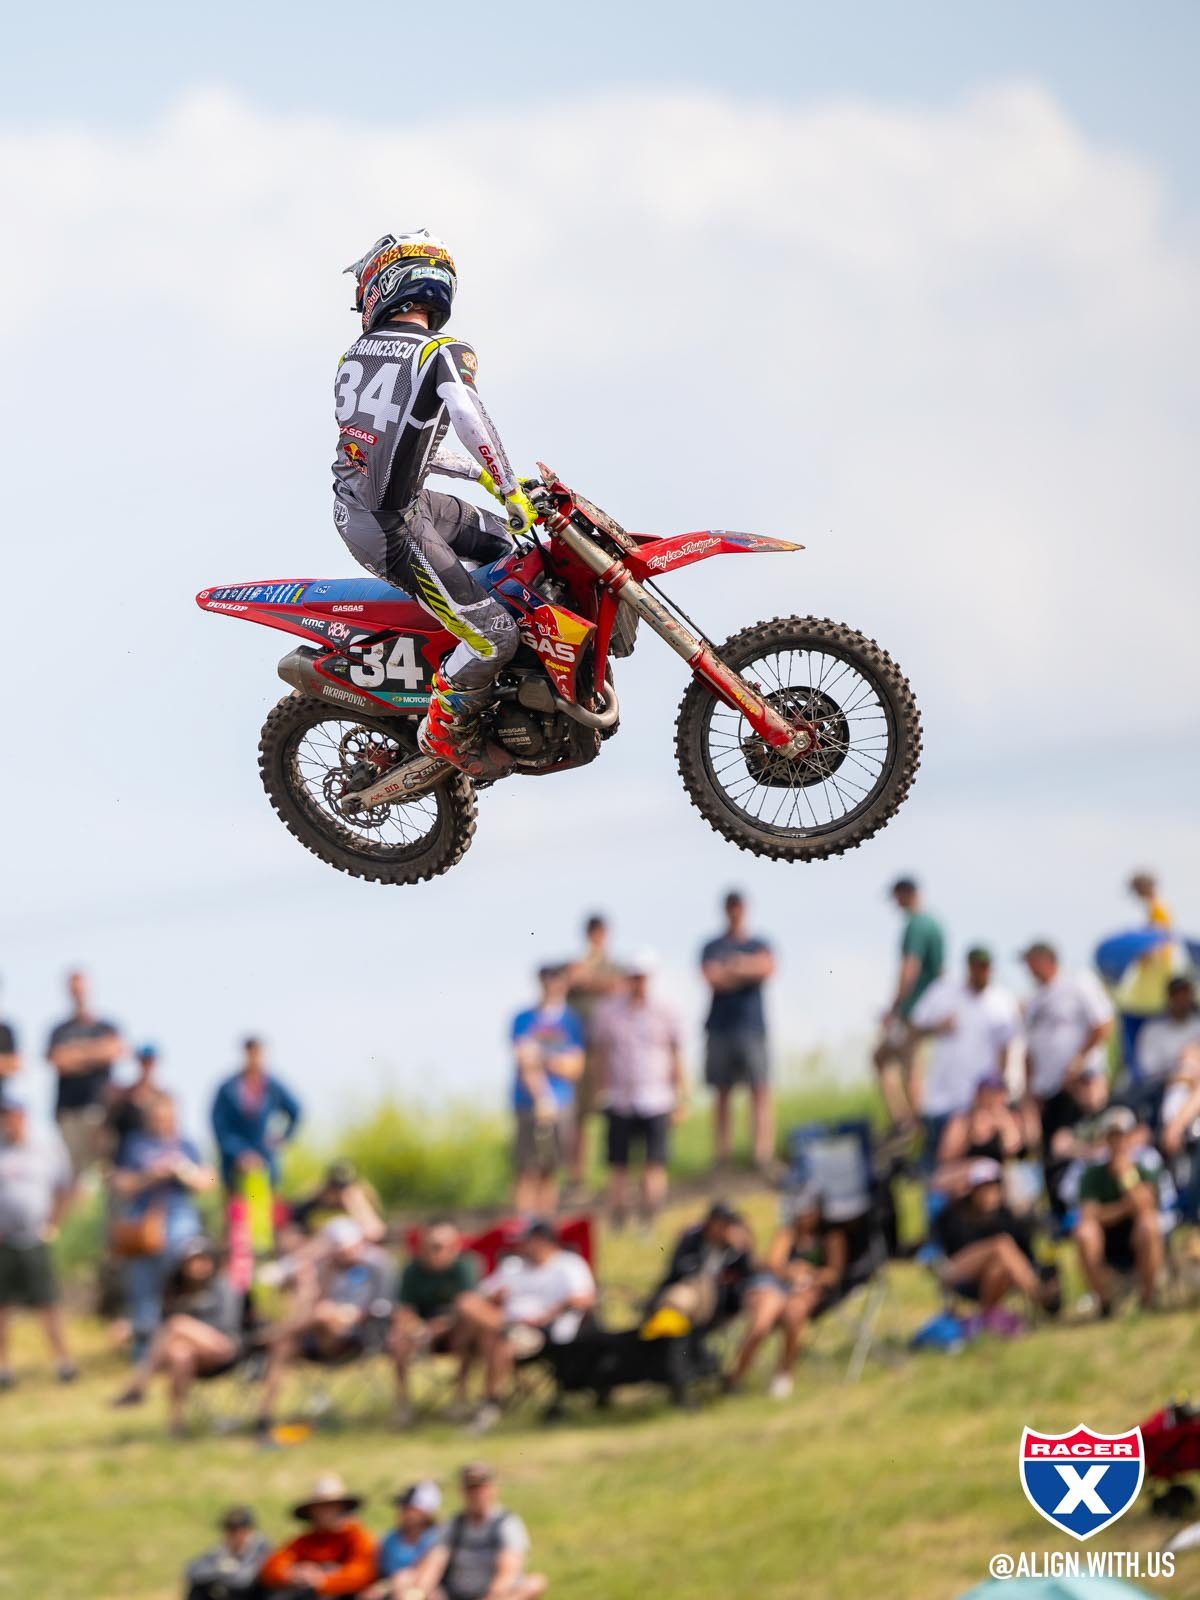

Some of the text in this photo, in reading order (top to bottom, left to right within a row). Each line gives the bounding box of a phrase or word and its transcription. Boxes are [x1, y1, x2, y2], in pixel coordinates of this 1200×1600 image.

[344, 338, 417, 359] FRANCESCO
[335, 360, 402, 433] 34
[340, 427, 375, 444] ASGAS
[647, 537, 721, 570] Troy Lee Designs
[206, 601, 248, 612] DUNLOP
[349, 634, 424, 690] 34
